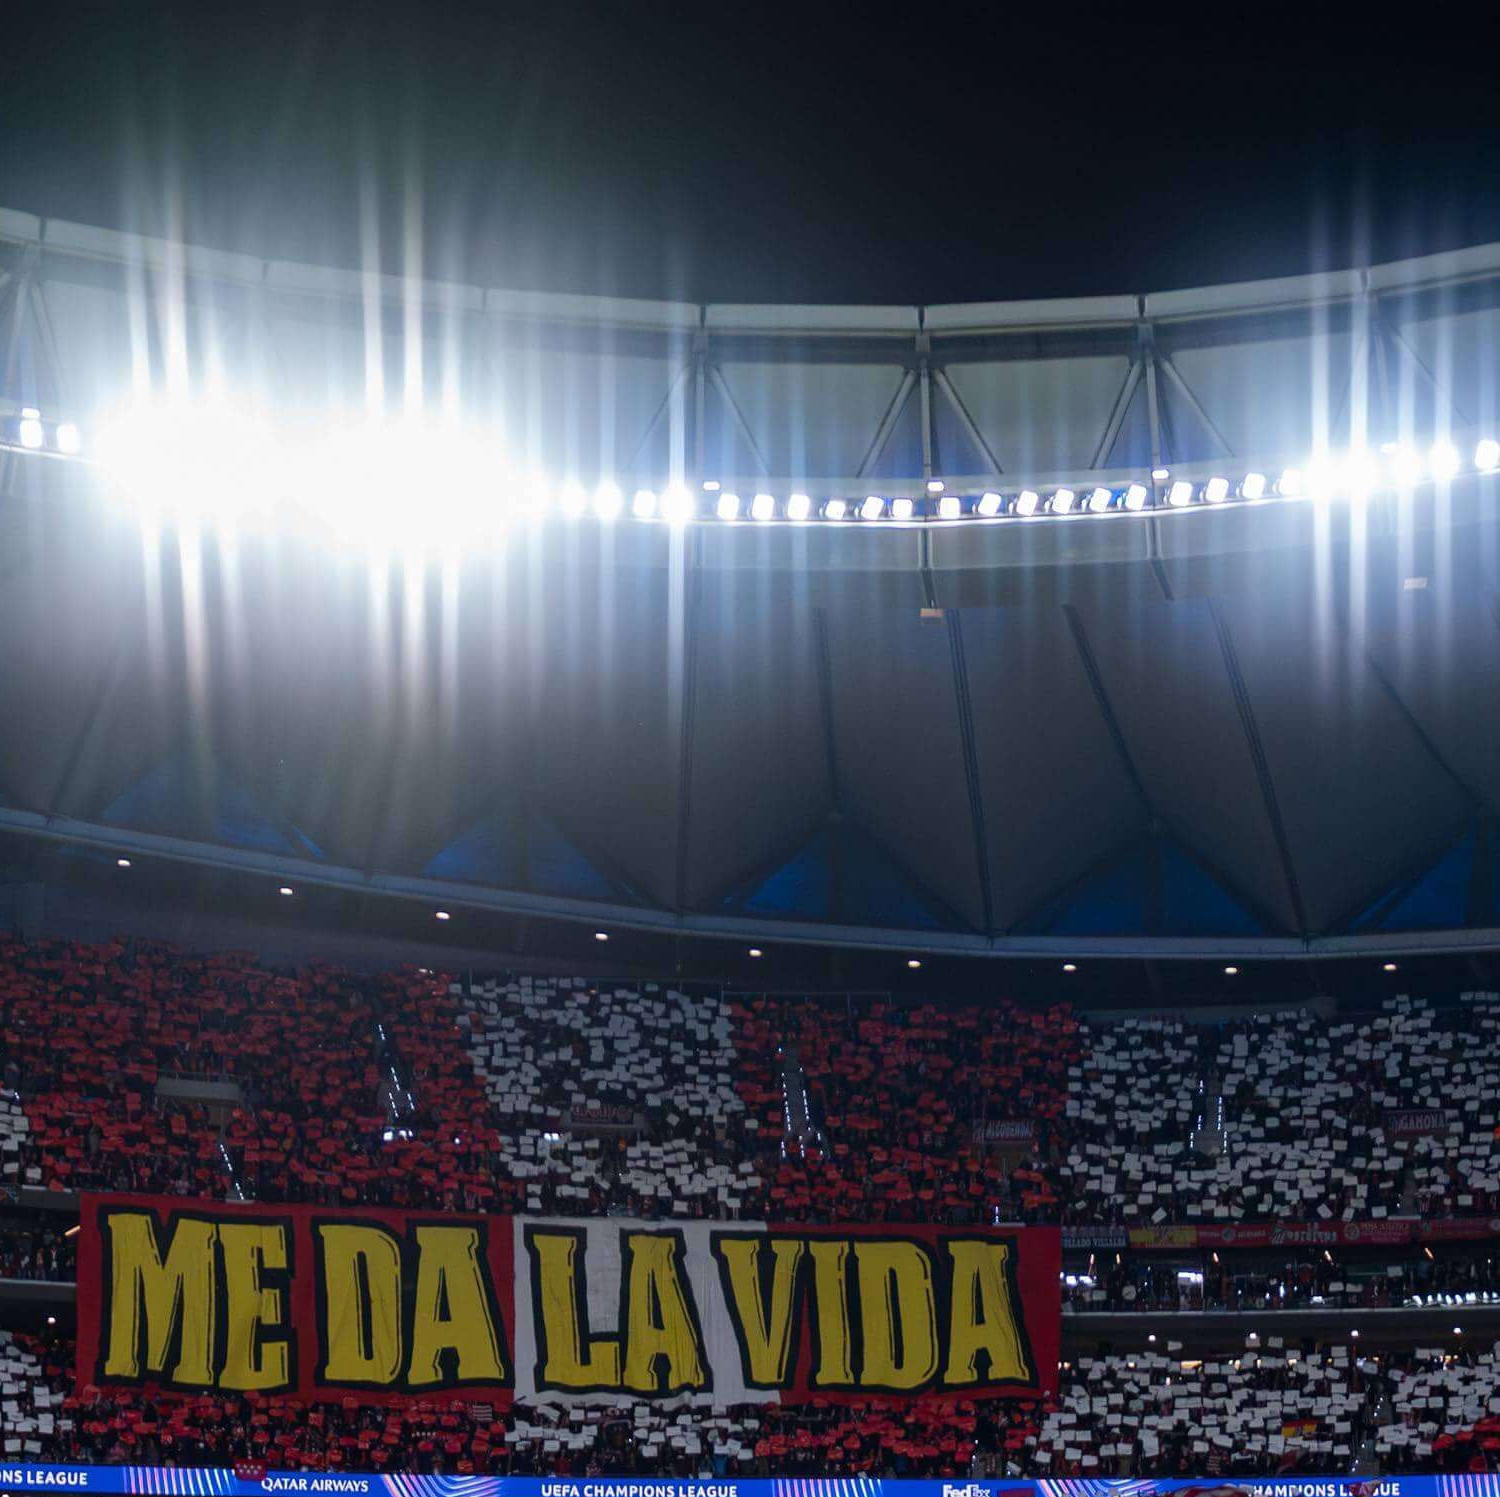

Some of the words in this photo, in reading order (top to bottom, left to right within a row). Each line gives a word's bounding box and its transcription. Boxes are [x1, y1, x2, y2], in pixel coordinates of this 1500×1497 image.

[101, 1209, 294, 1391] ME
[313, 1220, 509, 1388] DA
[529, 1230, 707, 1392] LA
[714, 1236, 1038, 1391] VIDA
[26, 1470, 88, 1486] LEAGUE
[261, 1477, 308, 1493] QATAR
[310, 1479, 369, 1493] AIRWAYS
[541, 1484, 580, 1497] UEFA
